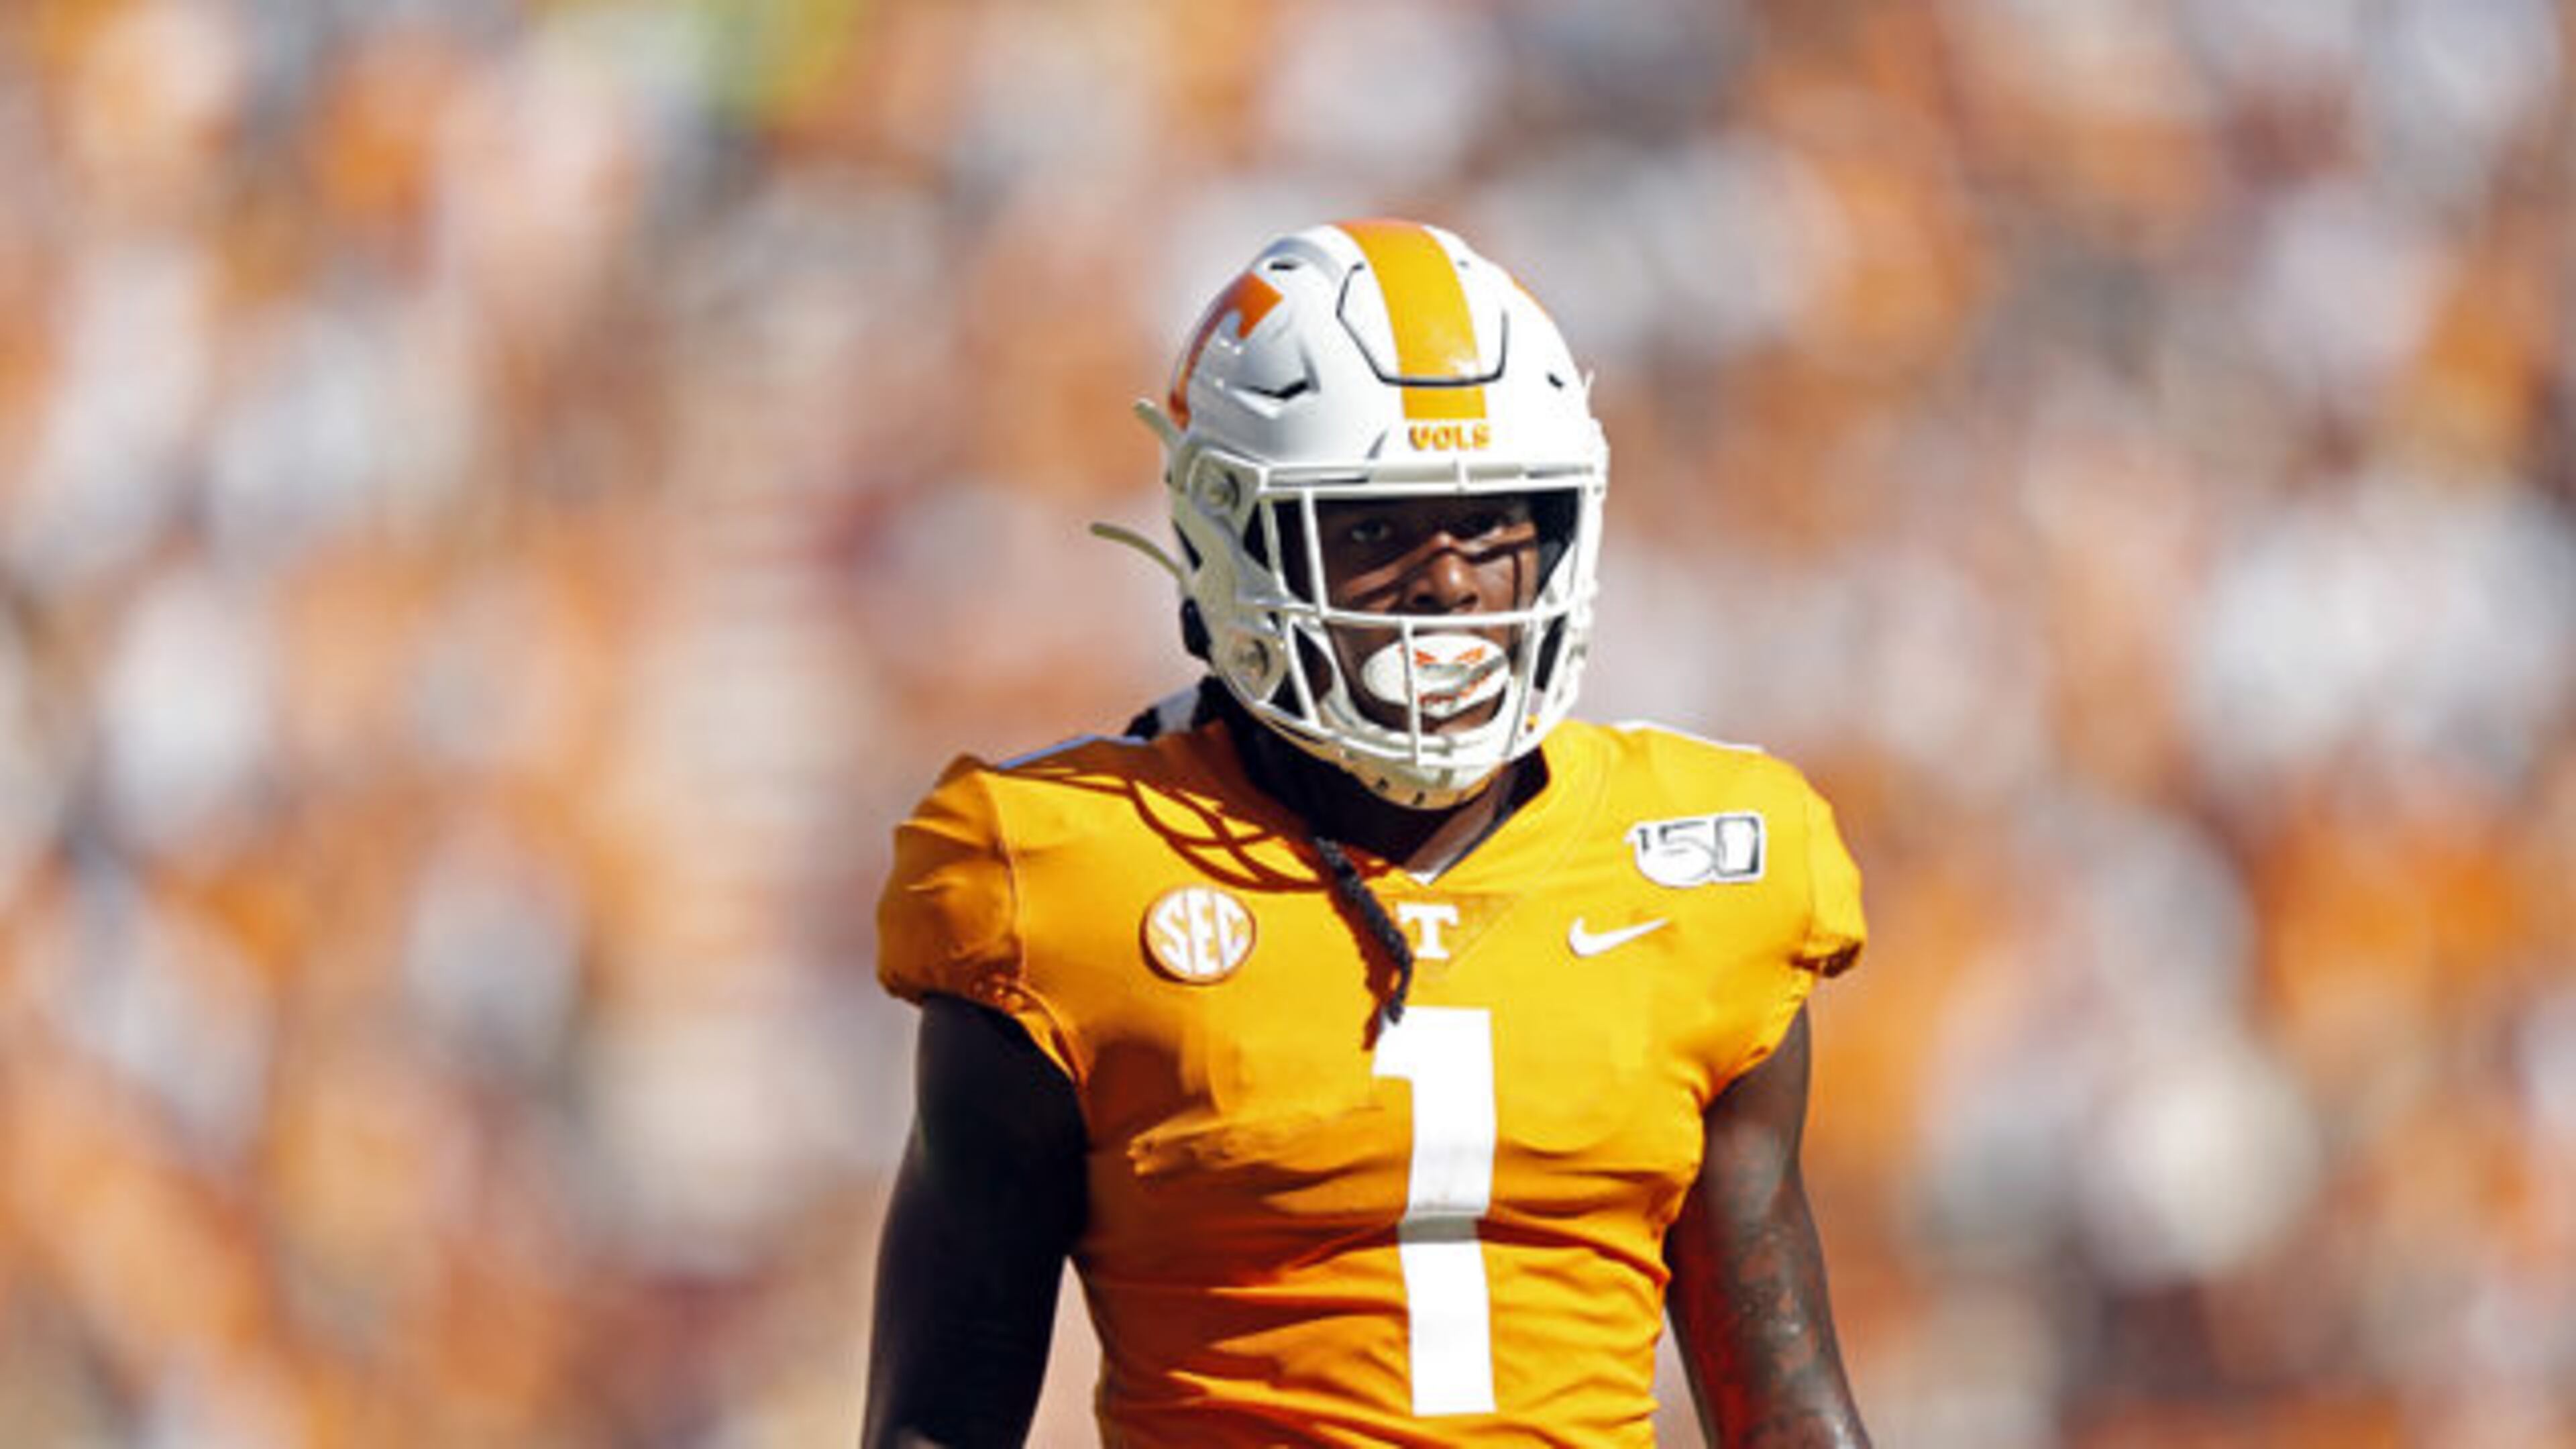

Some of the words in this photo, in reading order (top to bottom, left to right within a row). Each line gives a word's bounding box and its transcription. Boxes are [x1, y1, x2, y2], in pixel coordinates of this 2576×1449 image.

[1409, 424, 1491, 451] VOLS
[1152, 888, 1252, 975] SEC
[1397, 902, 1459, 959] T
[1371, 1006, 1497, 1416] 1
